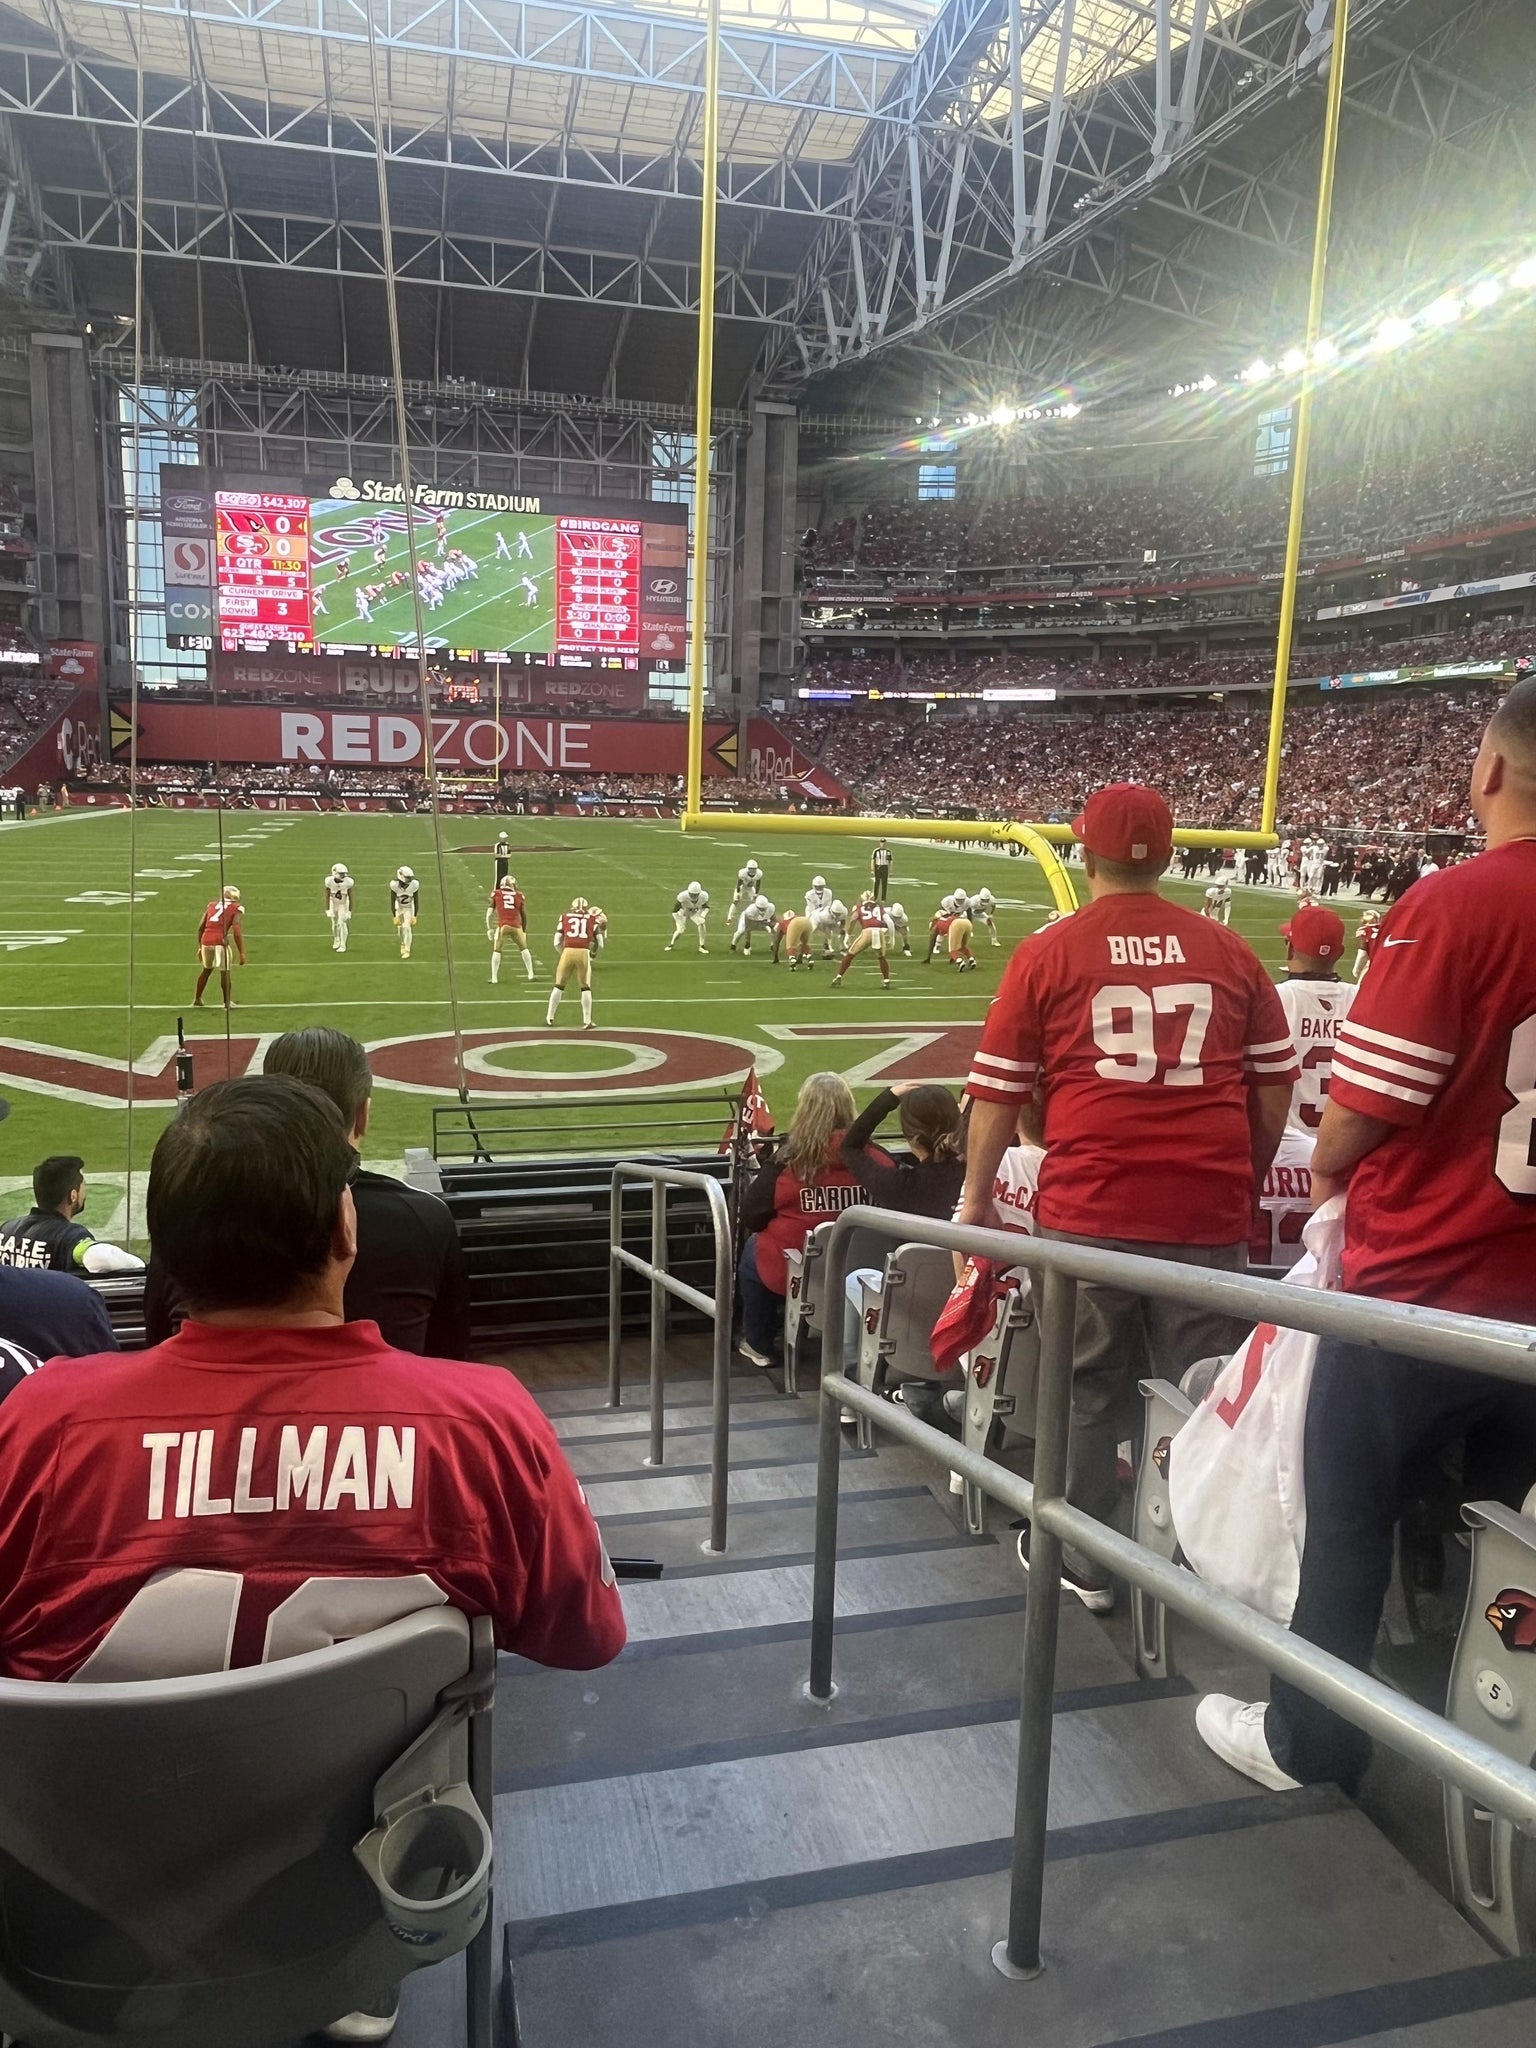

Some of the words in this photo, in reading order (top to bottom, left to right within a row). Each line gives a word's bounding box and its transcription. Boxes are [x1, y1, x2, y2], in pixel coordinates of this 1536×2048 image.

[263, 496, 307, 509] $42,307
[466, 493, 540, 513] STADIUM
[275, 516, 291, 533] 0
[560, 519, 640, 533] #BIRDGANG
[276, 538, 291, 556] 0
[223, 557, 230, 567] 1
[236, 558, 262, 568] QTR
[271, 560, 302, 570] 11:30
[228, 574, 234, 584] 1
[256, 575, 264, 585] 5
[287, 576, 296, 587] 5
[575, 576, 583, 584] 2
[228, 587, 270, 596] CURRENT
[272, 589, 298, 598] DRIVE
[575, 593, 582, 602] 5
[170, 602, 216, 619] COX
[221, 606, 256, 616] DOWNS
[225, 598, 250, 606] FIRST
[277, 602, 288, 616] 3
[222, 628, 306, 641] 623-400-2210
[558, 644, 597, 652] PROTECT
[345, 666, 419, 693] BUD
[503, 895, 515, 909] 2
[567, 917, 588, 938] 31
[1106, 935, 1187, 967] BOSA
[1091, 983, 1213, 1087] 97
[142, 1425, 416, 1521] TILLMAN
[1490, 1683, 1501, 1699] 5
